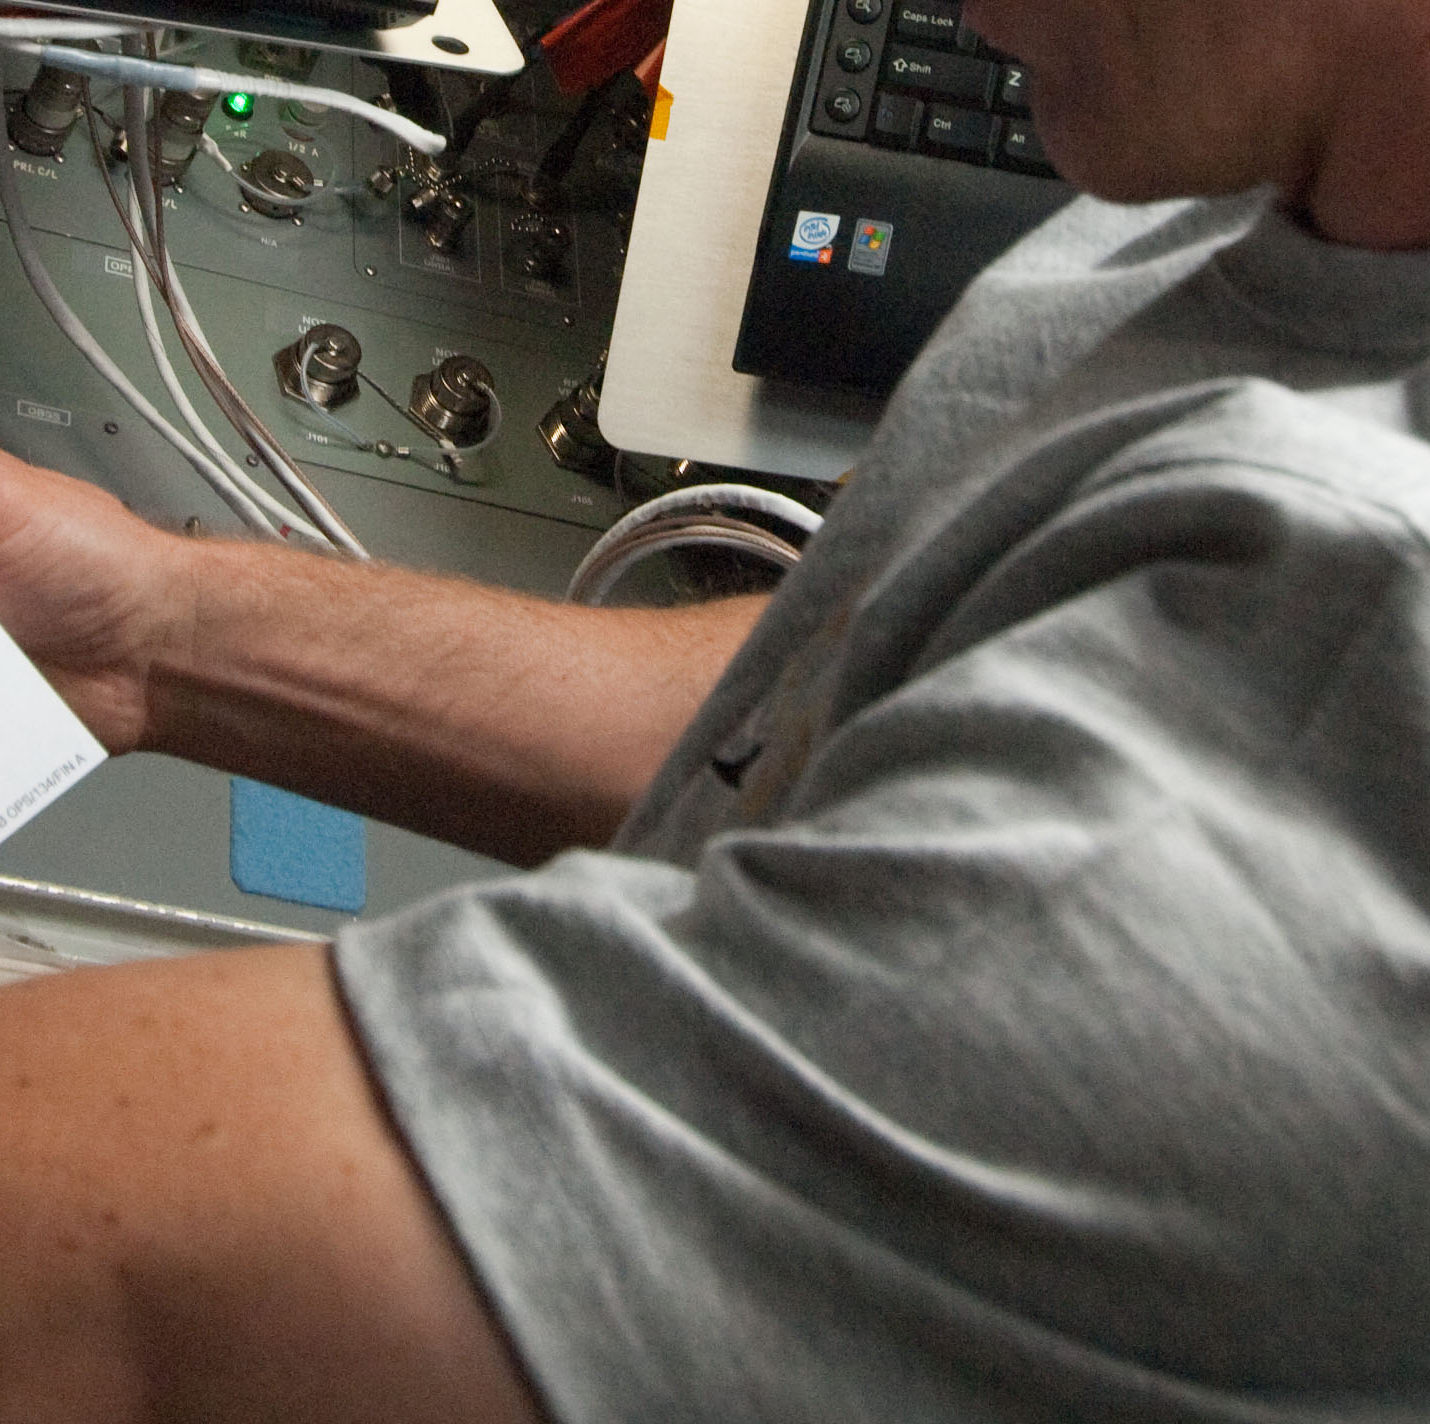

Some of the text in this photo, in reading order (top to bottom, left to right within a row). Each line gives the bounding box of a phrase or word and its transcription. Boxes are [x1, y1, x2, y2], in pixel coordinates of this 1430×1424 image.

[902, 9, 955, 28] Caps Lock
[909, 61, 932, 75] Shift
[1008, 70, 1022, 87] Z
[933, 117, 952, 131] Ctrl
[37, 164, 58, 180] C/L
[260, 235, 278, 249] N/A
[3, 758, 78, 822] OPS/134/FIN
[71, 749, 89, 767] A
